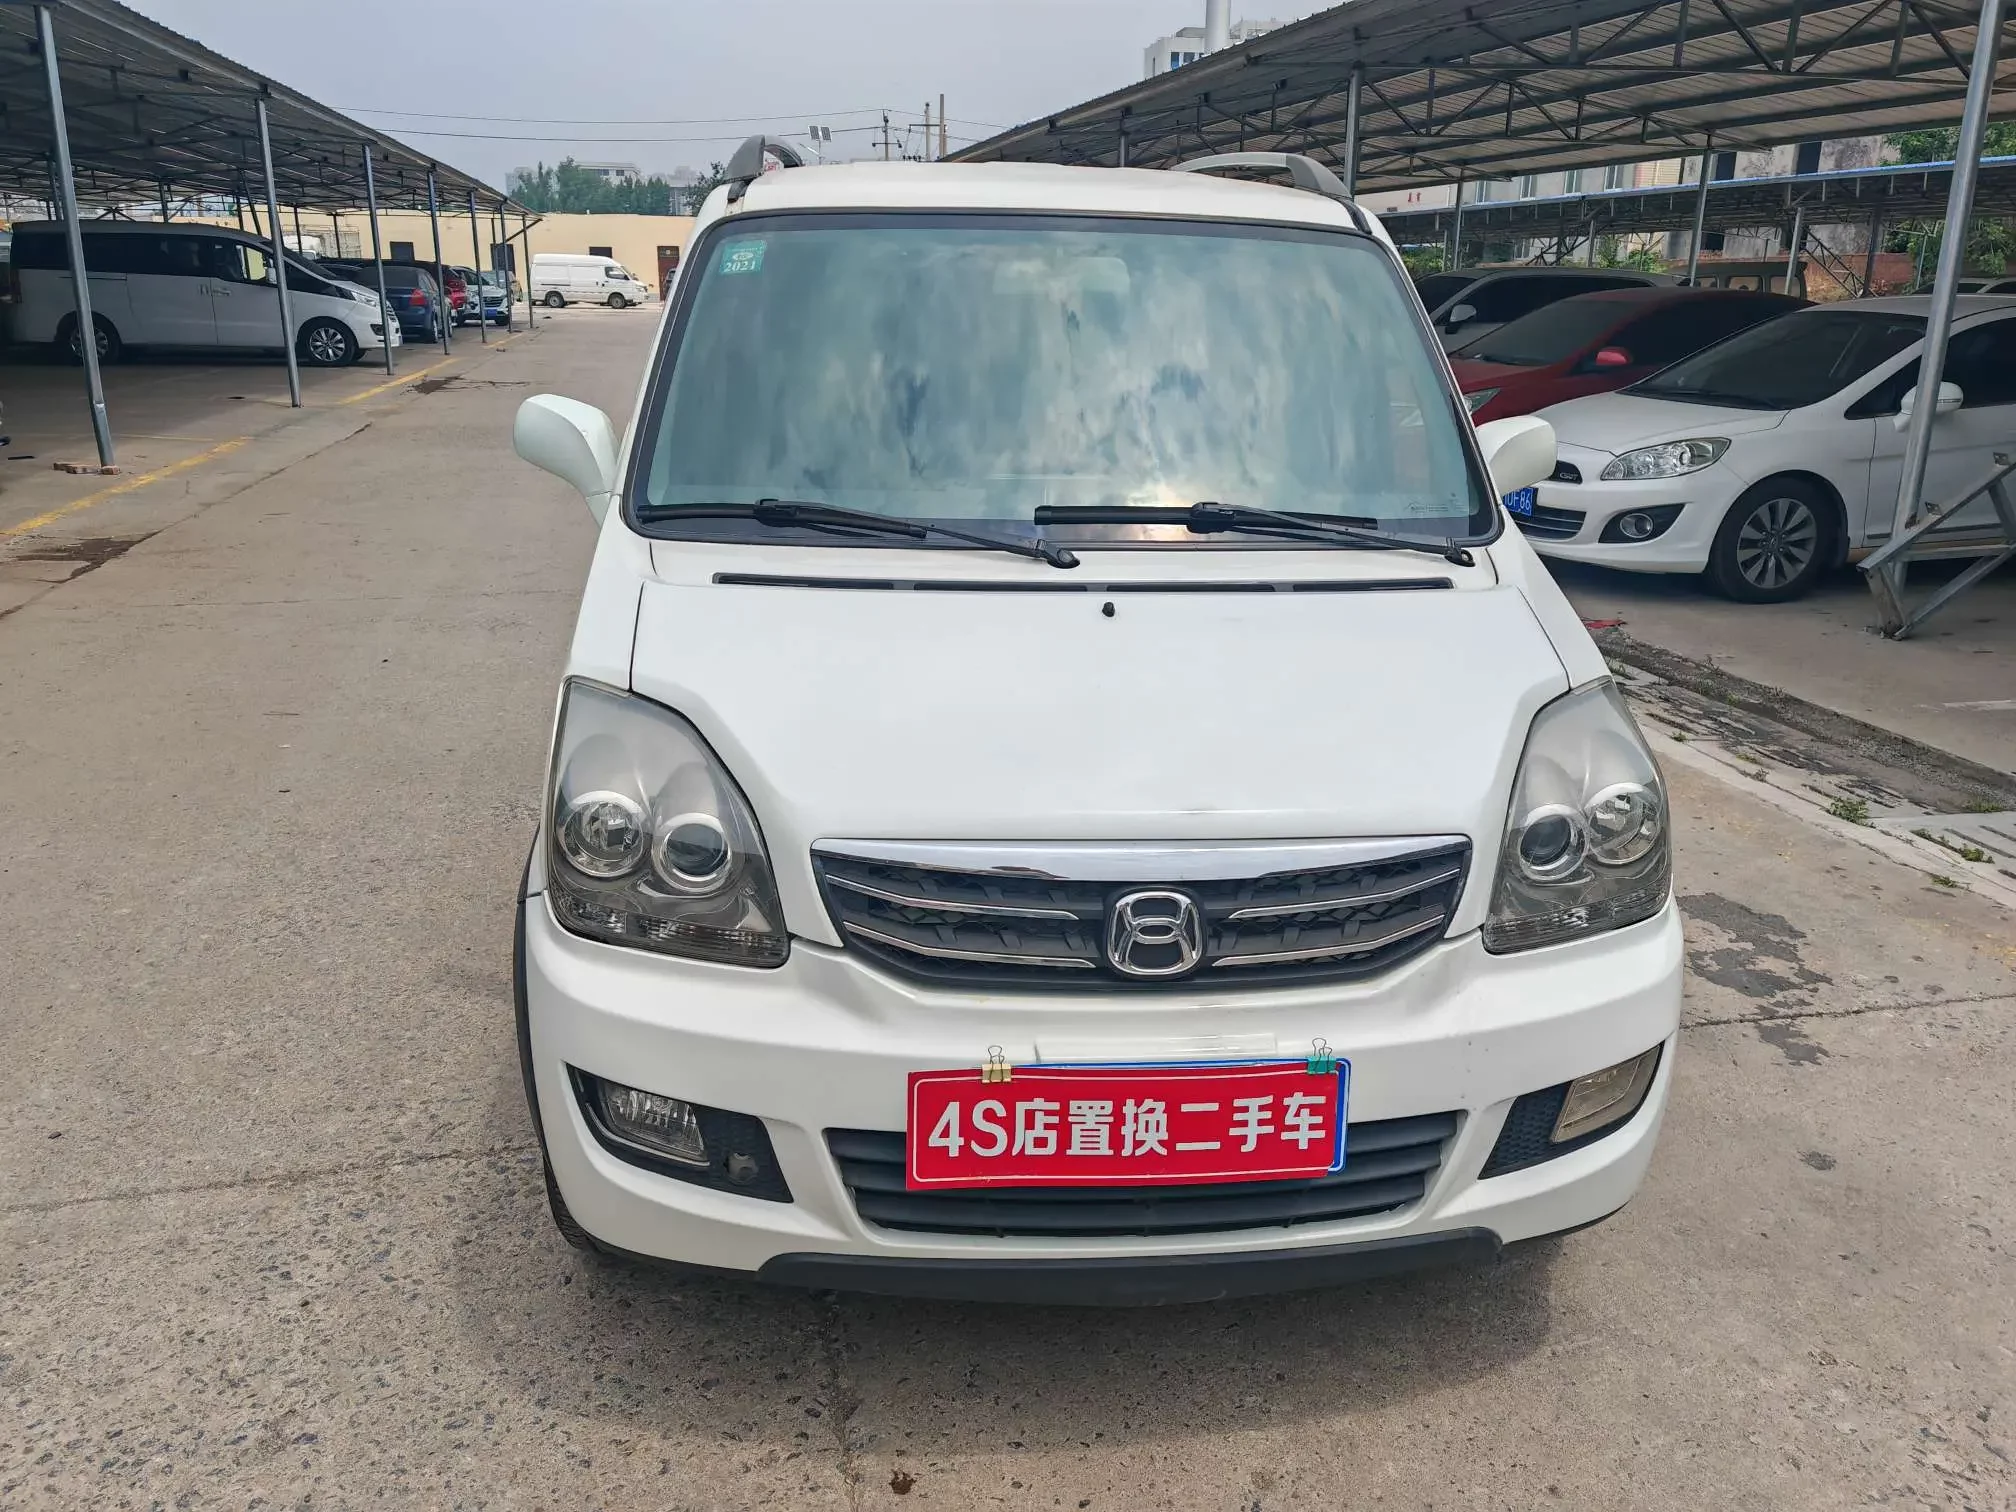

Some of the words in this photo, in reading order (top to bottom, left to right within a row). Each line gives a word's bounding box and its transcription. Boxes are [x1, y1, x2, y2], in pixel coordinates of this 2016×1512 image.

[928, 1091, 1327, 1158] 4S店置换二手车
